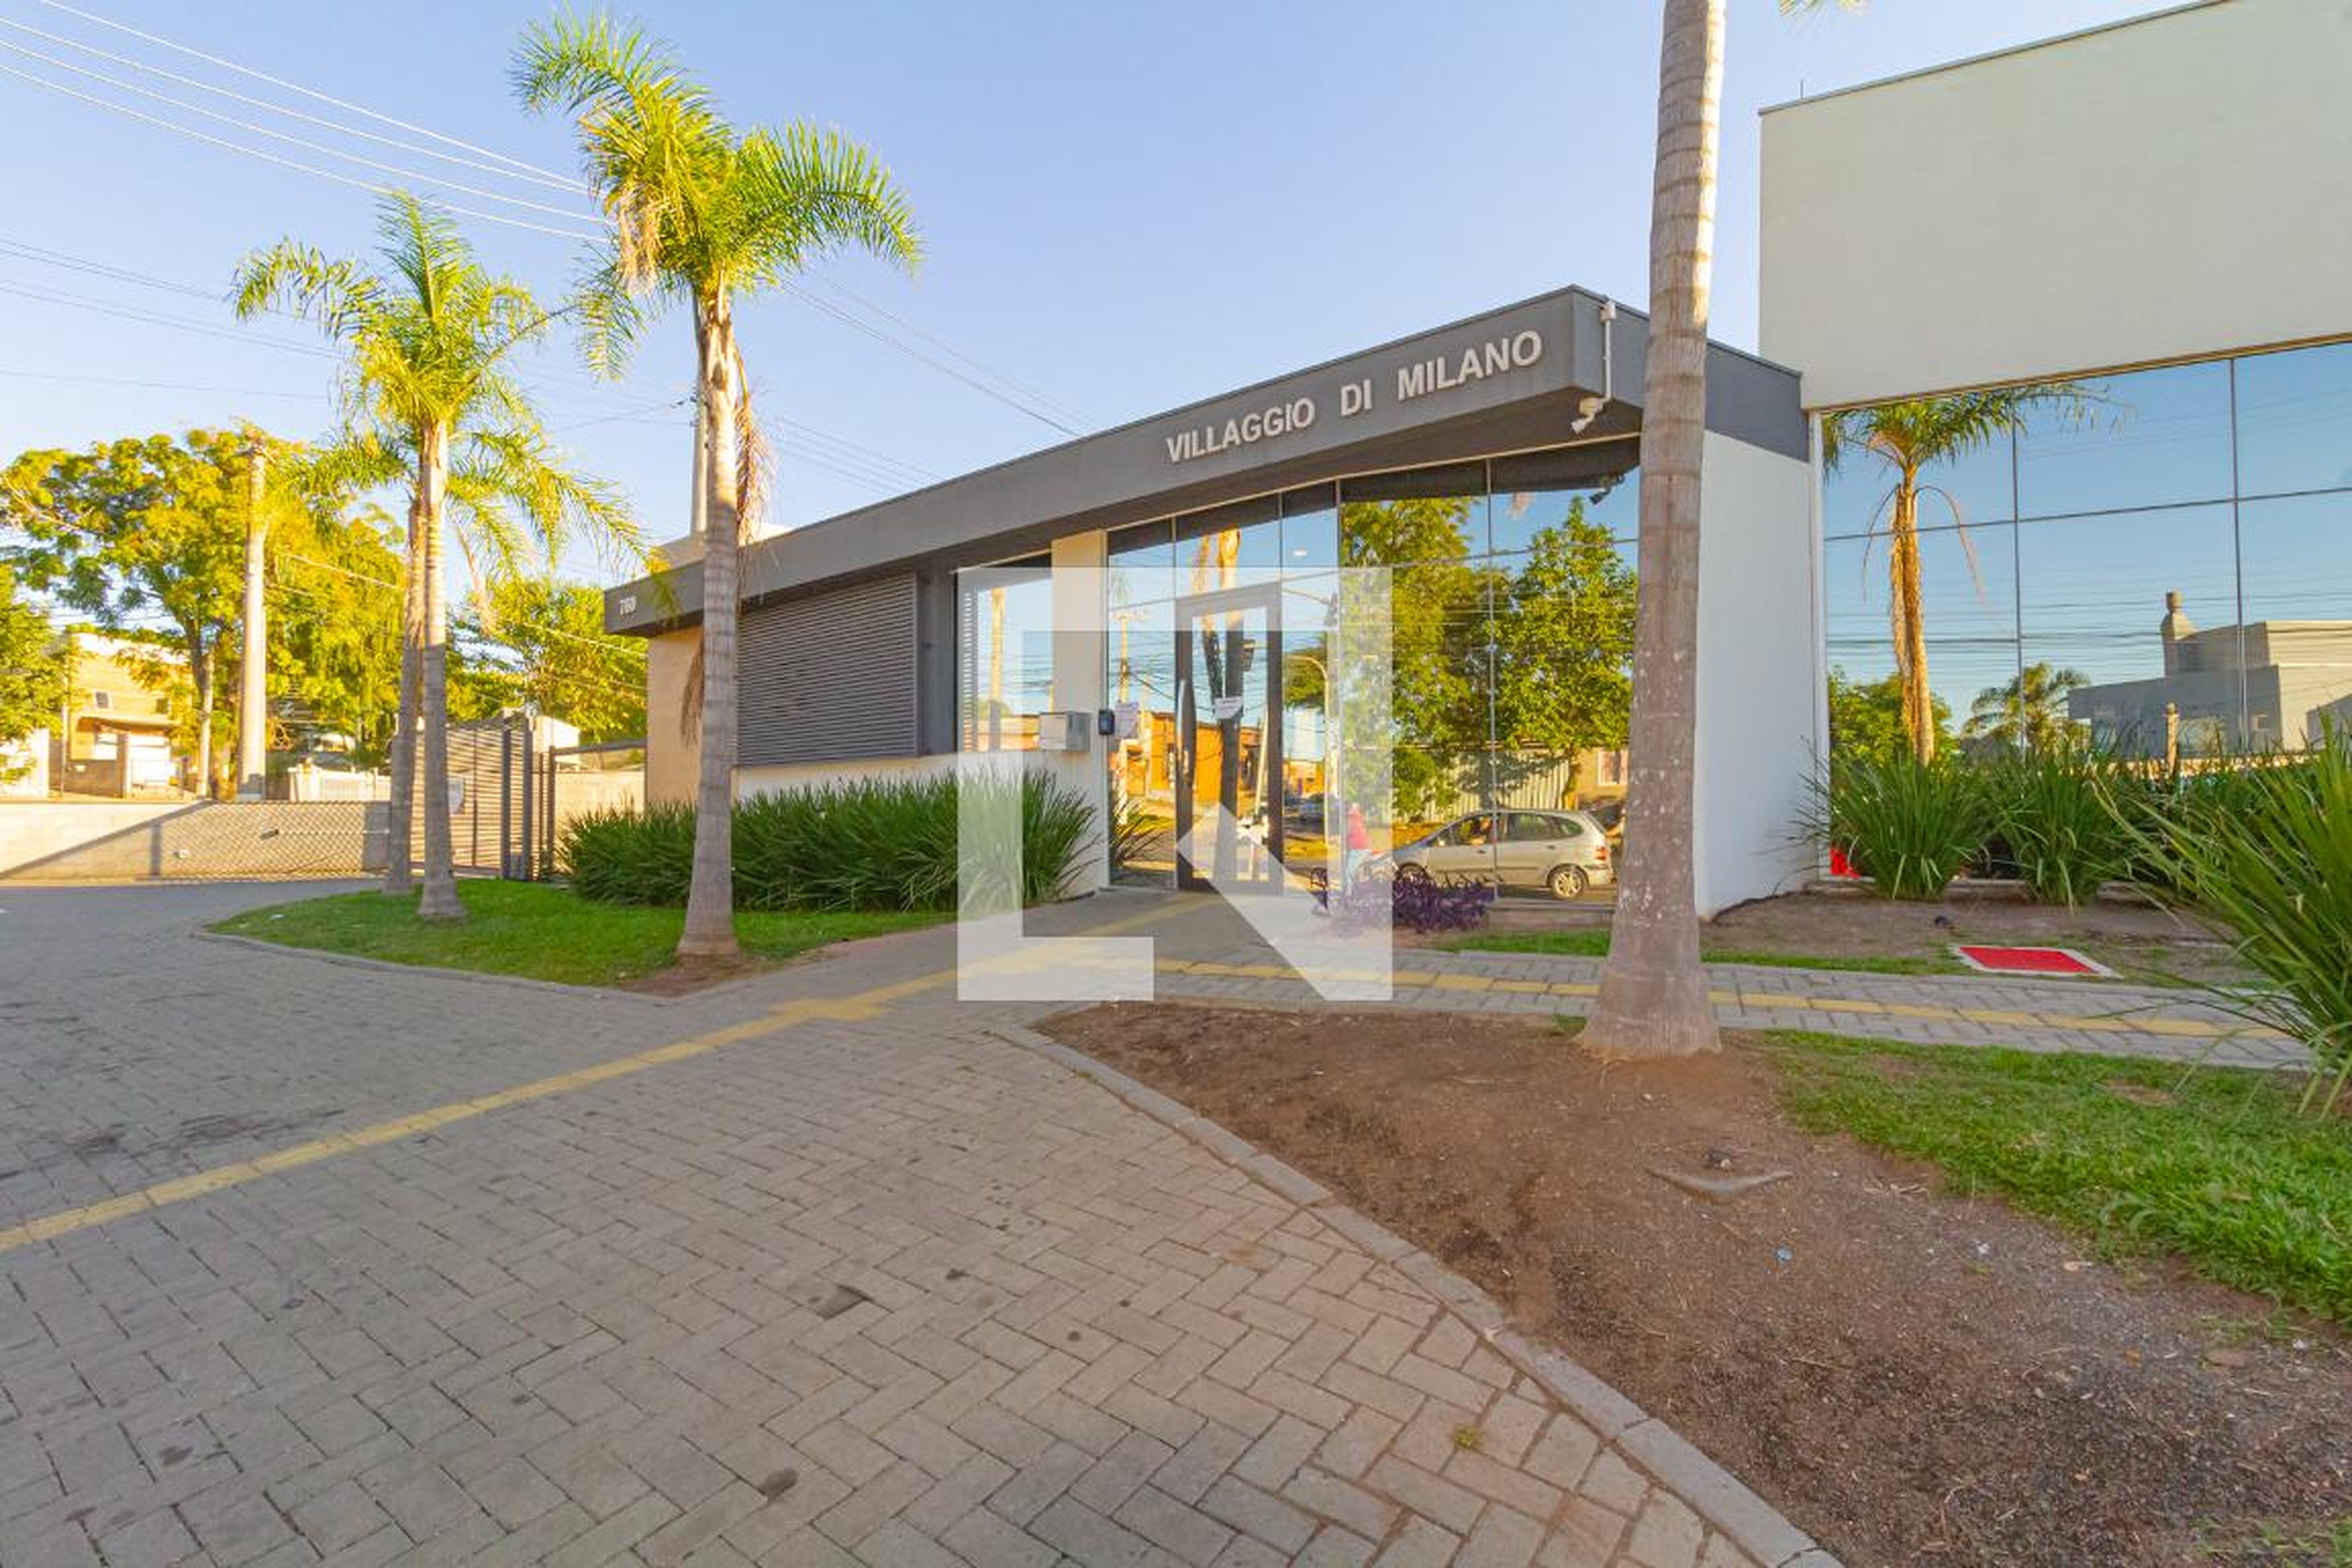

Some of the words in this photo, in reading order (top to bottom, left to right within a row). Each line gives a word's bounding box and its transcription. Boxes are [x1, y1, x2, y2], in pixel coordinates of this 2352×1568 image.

[1166, 398, 1315, 462] VILLAGGIO
[1341, 379, 1372, 417] DI
[1398, 331, 1542, 401] MILANO
